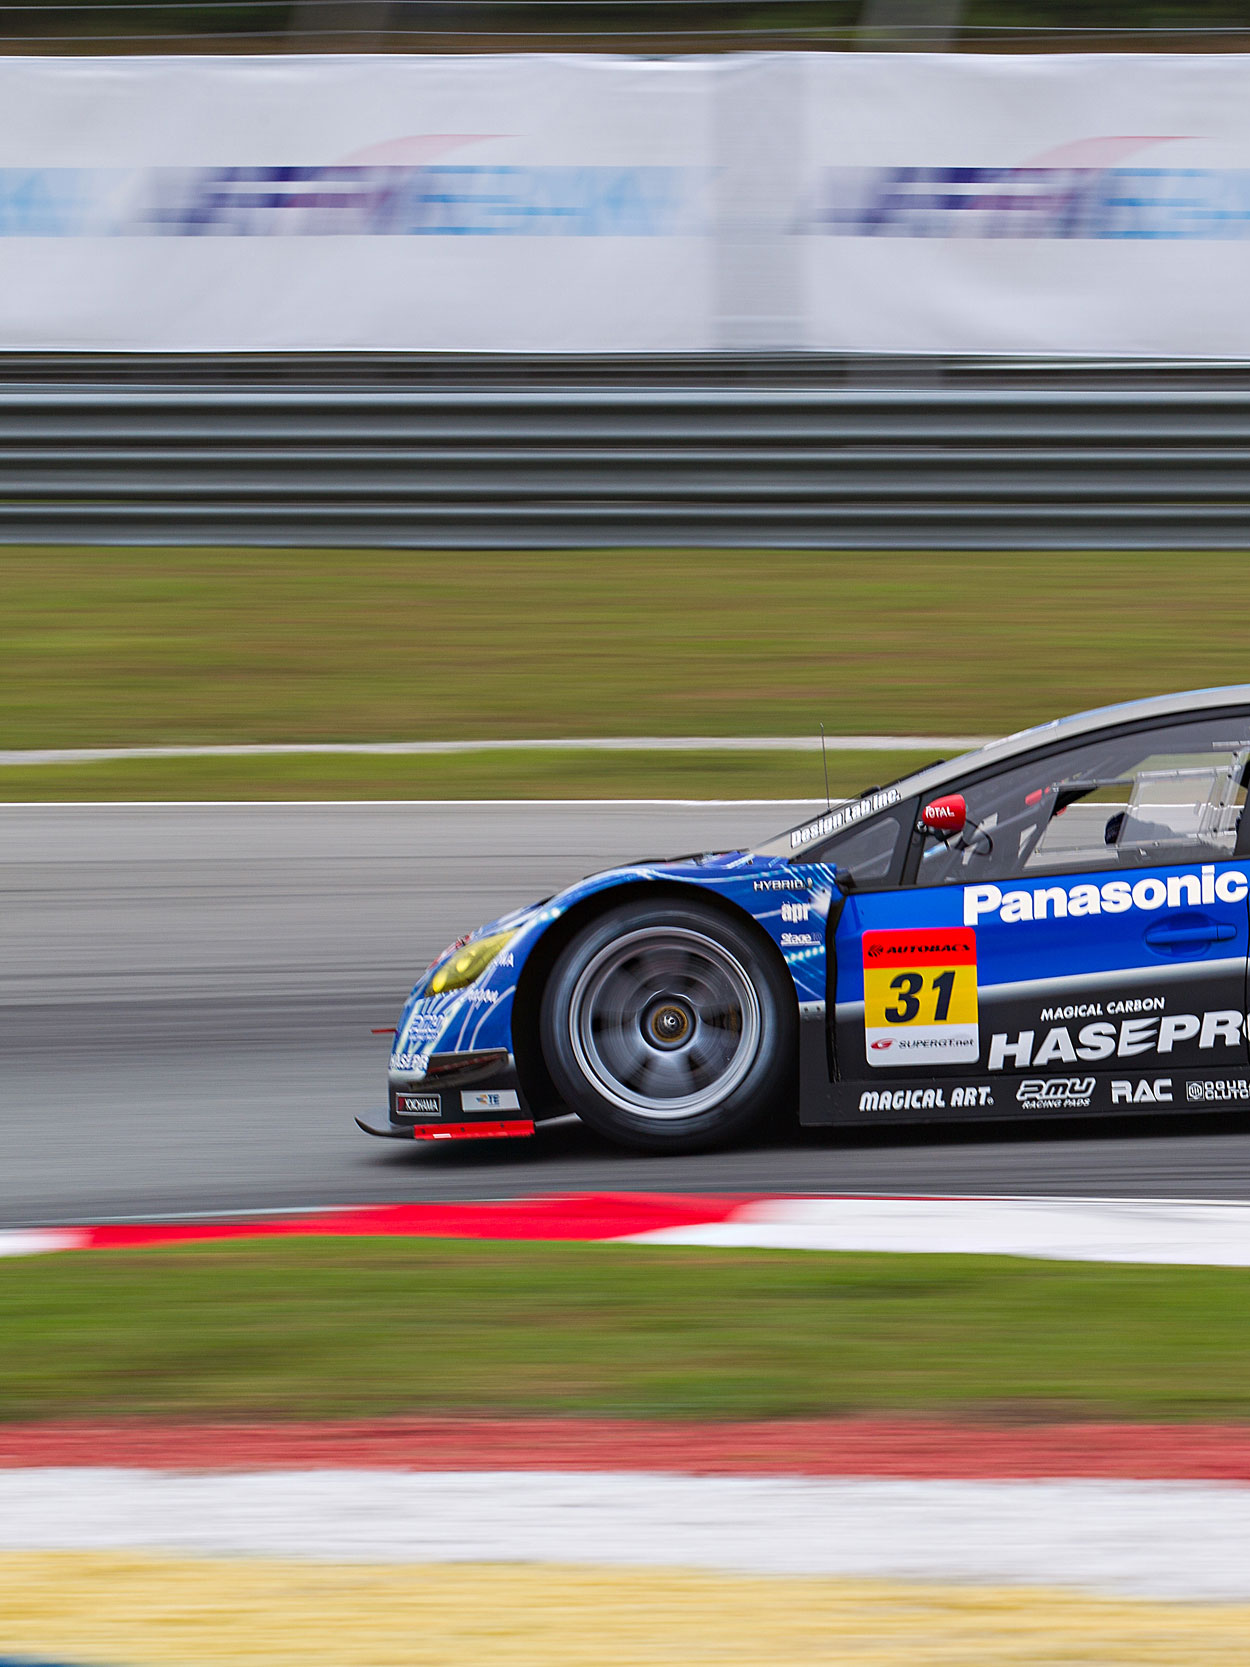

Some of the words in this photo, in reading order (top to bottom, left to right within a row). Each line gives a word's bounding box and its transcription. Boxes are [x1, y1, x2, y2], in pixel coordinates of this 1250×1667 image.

[790, 812, 844, 848] Design
[844, 799, 871, 824] Lab
[925, 805, 955, 819] TOTAL
[963, 865, 1249, 927] Panasonic
[885, 971, 955, 1023] 31
[1040, 1003, 1103, 1021] MAGICAL
[1106, 997, 1165, 1015] CARBON
[859, 1088, 945, 1111] MAGICAL
[1111, 1078, 1174, 1104] RAC
